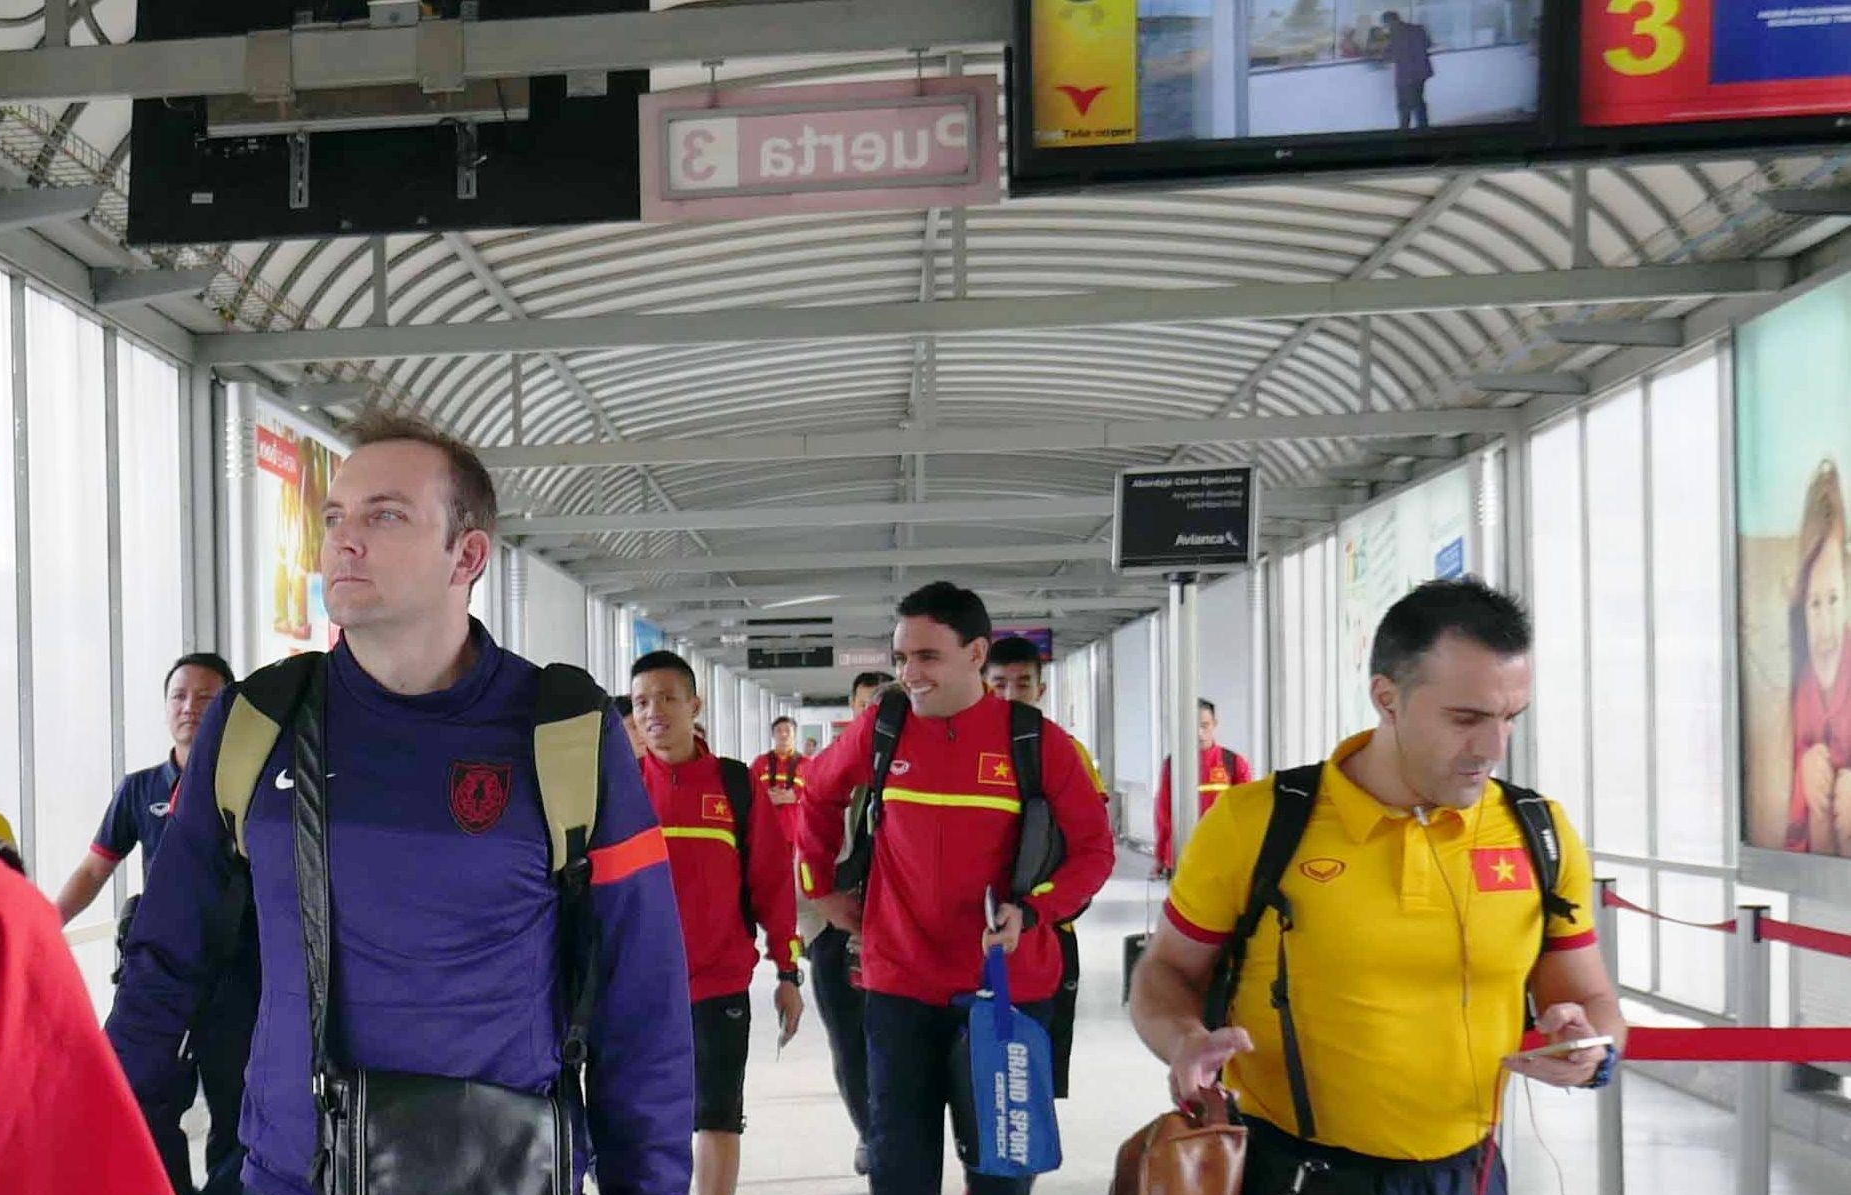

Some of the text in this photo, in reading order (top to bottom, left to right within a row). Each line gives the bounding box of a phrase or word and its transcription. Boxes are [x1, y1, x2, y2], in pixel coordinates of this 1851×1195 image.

[1603, 0, 1685, 76] 3
[1174, 534, 1225, 547] Avianca
[1008, 1042, 1030, 1166] GRAND SPORT
